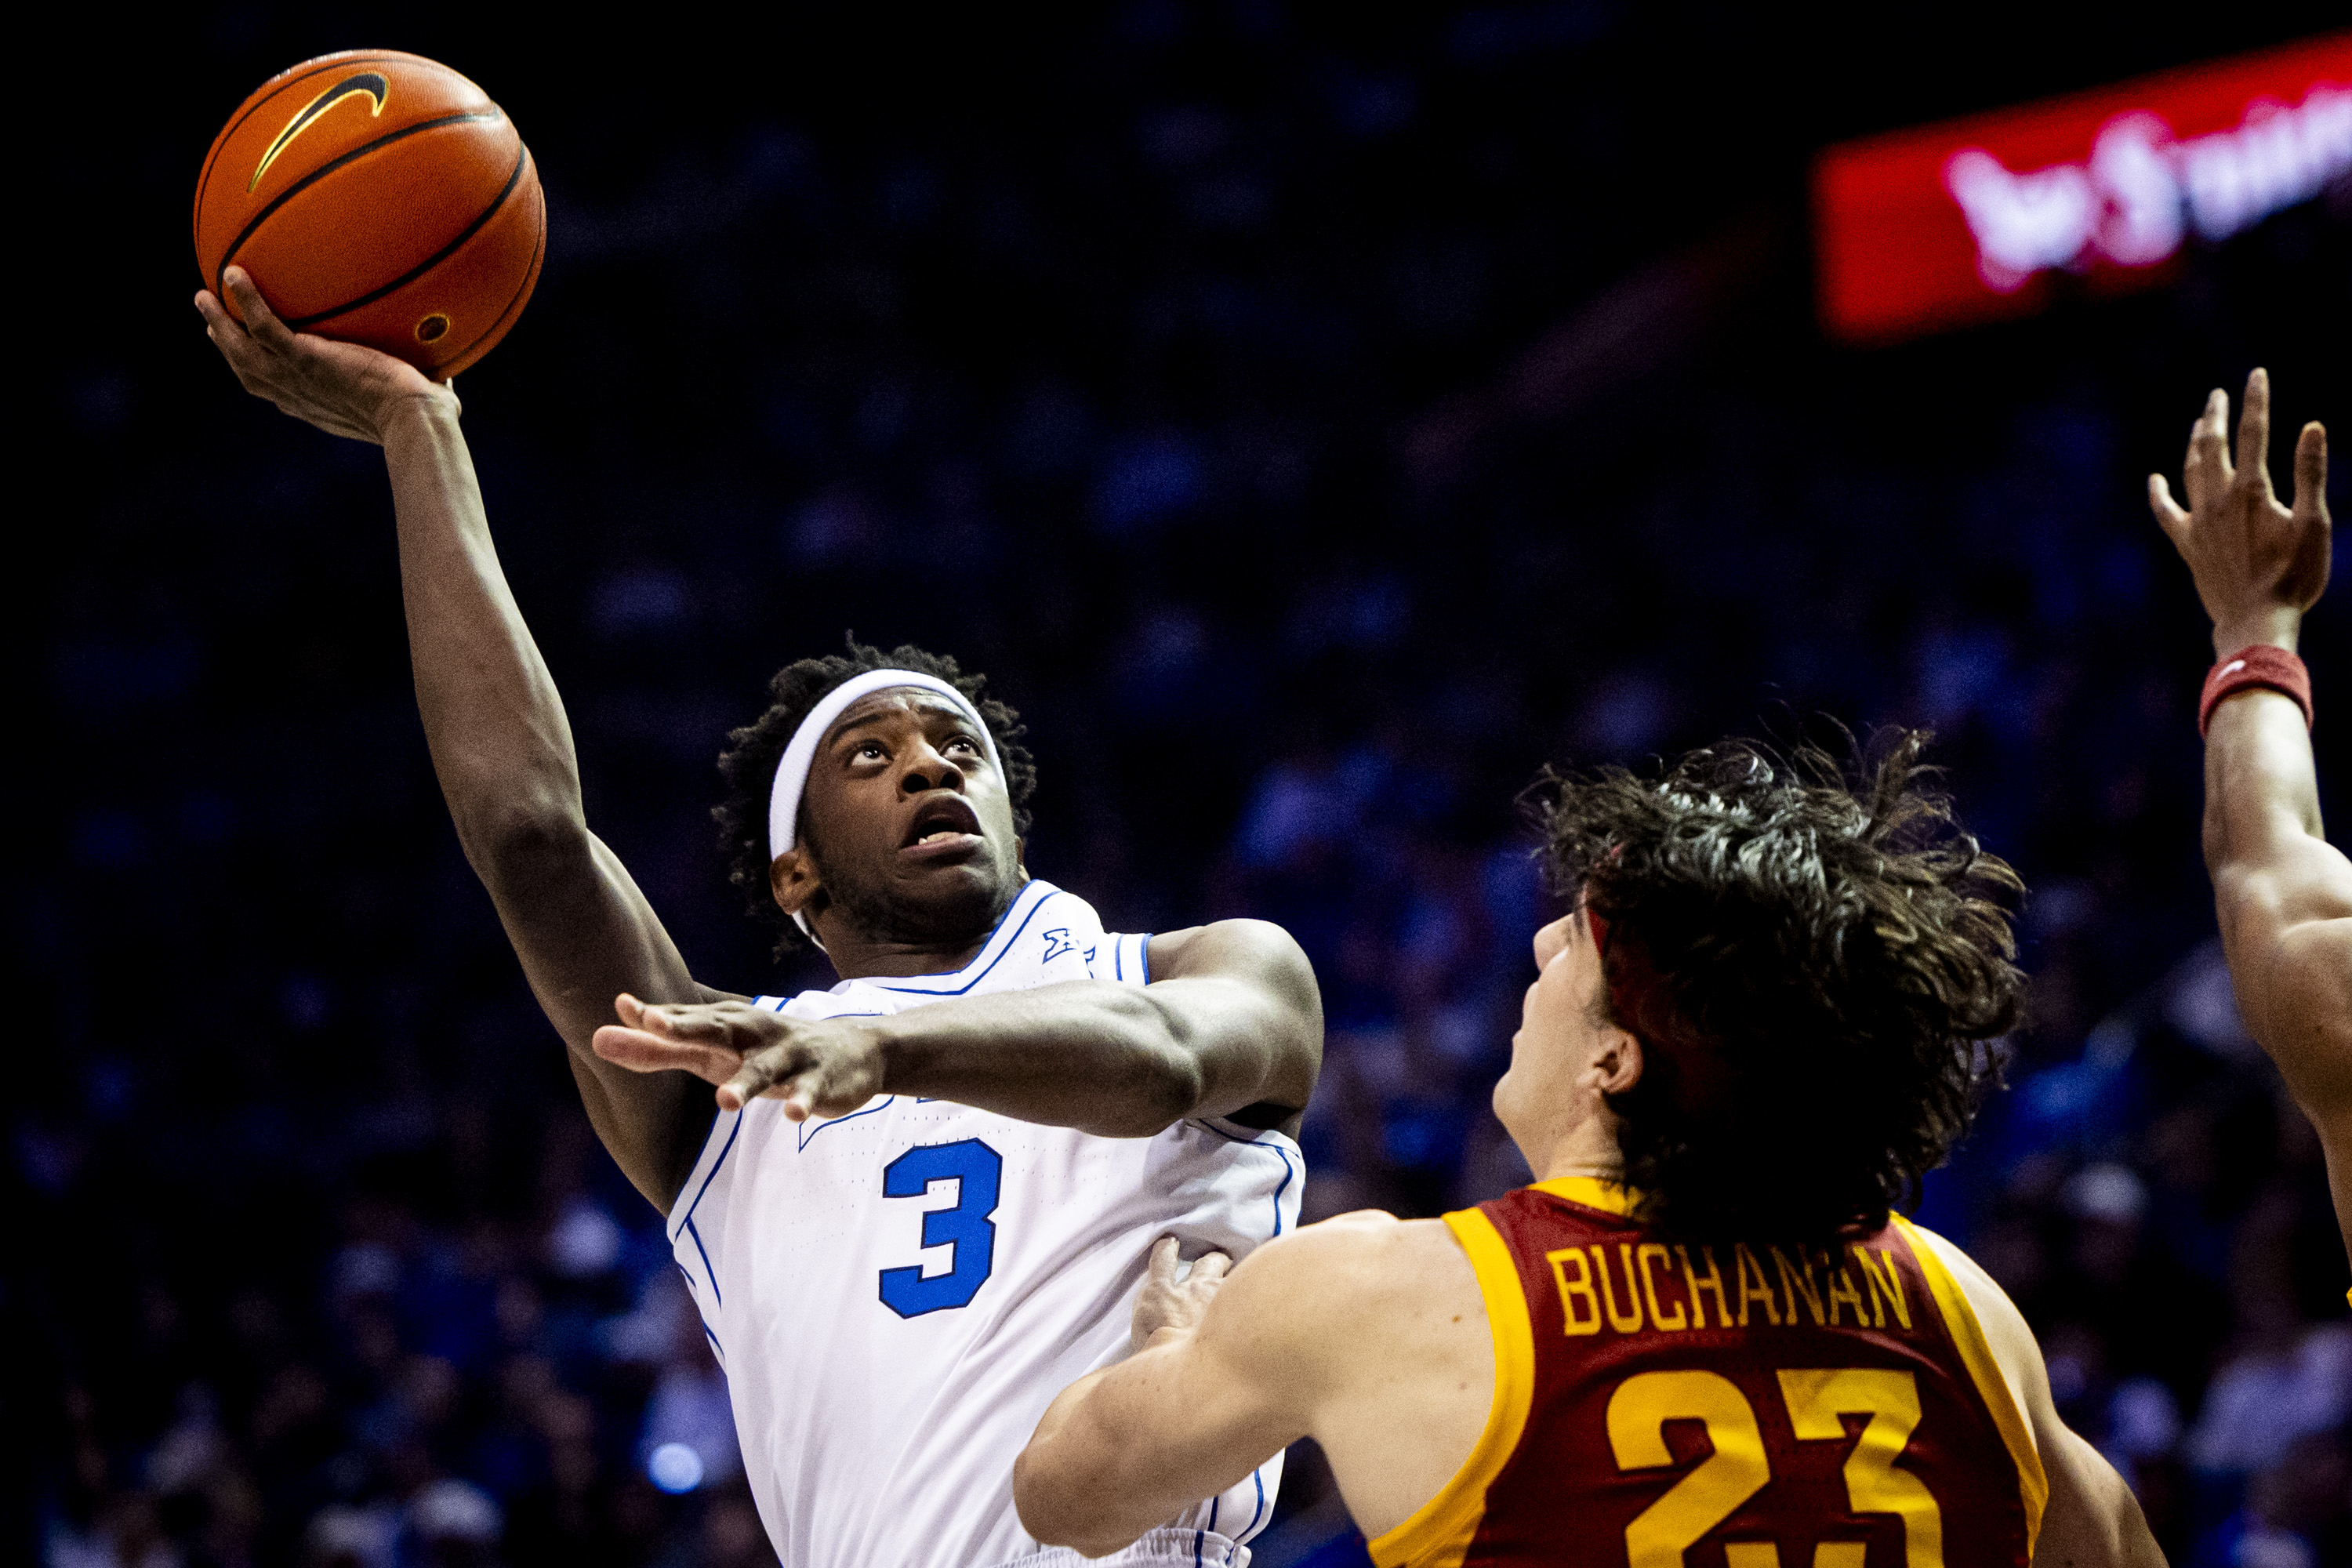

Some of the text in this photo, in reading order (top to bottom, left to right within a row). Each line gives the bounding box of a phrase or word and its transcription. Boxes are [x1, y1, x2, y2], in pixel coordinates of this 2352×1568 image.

[879, 1137, 1003, 1319] 3
[1545, 1243, 1912, 1336] BUCHANAN
[1606, 1369, 1944, 1568] 23
